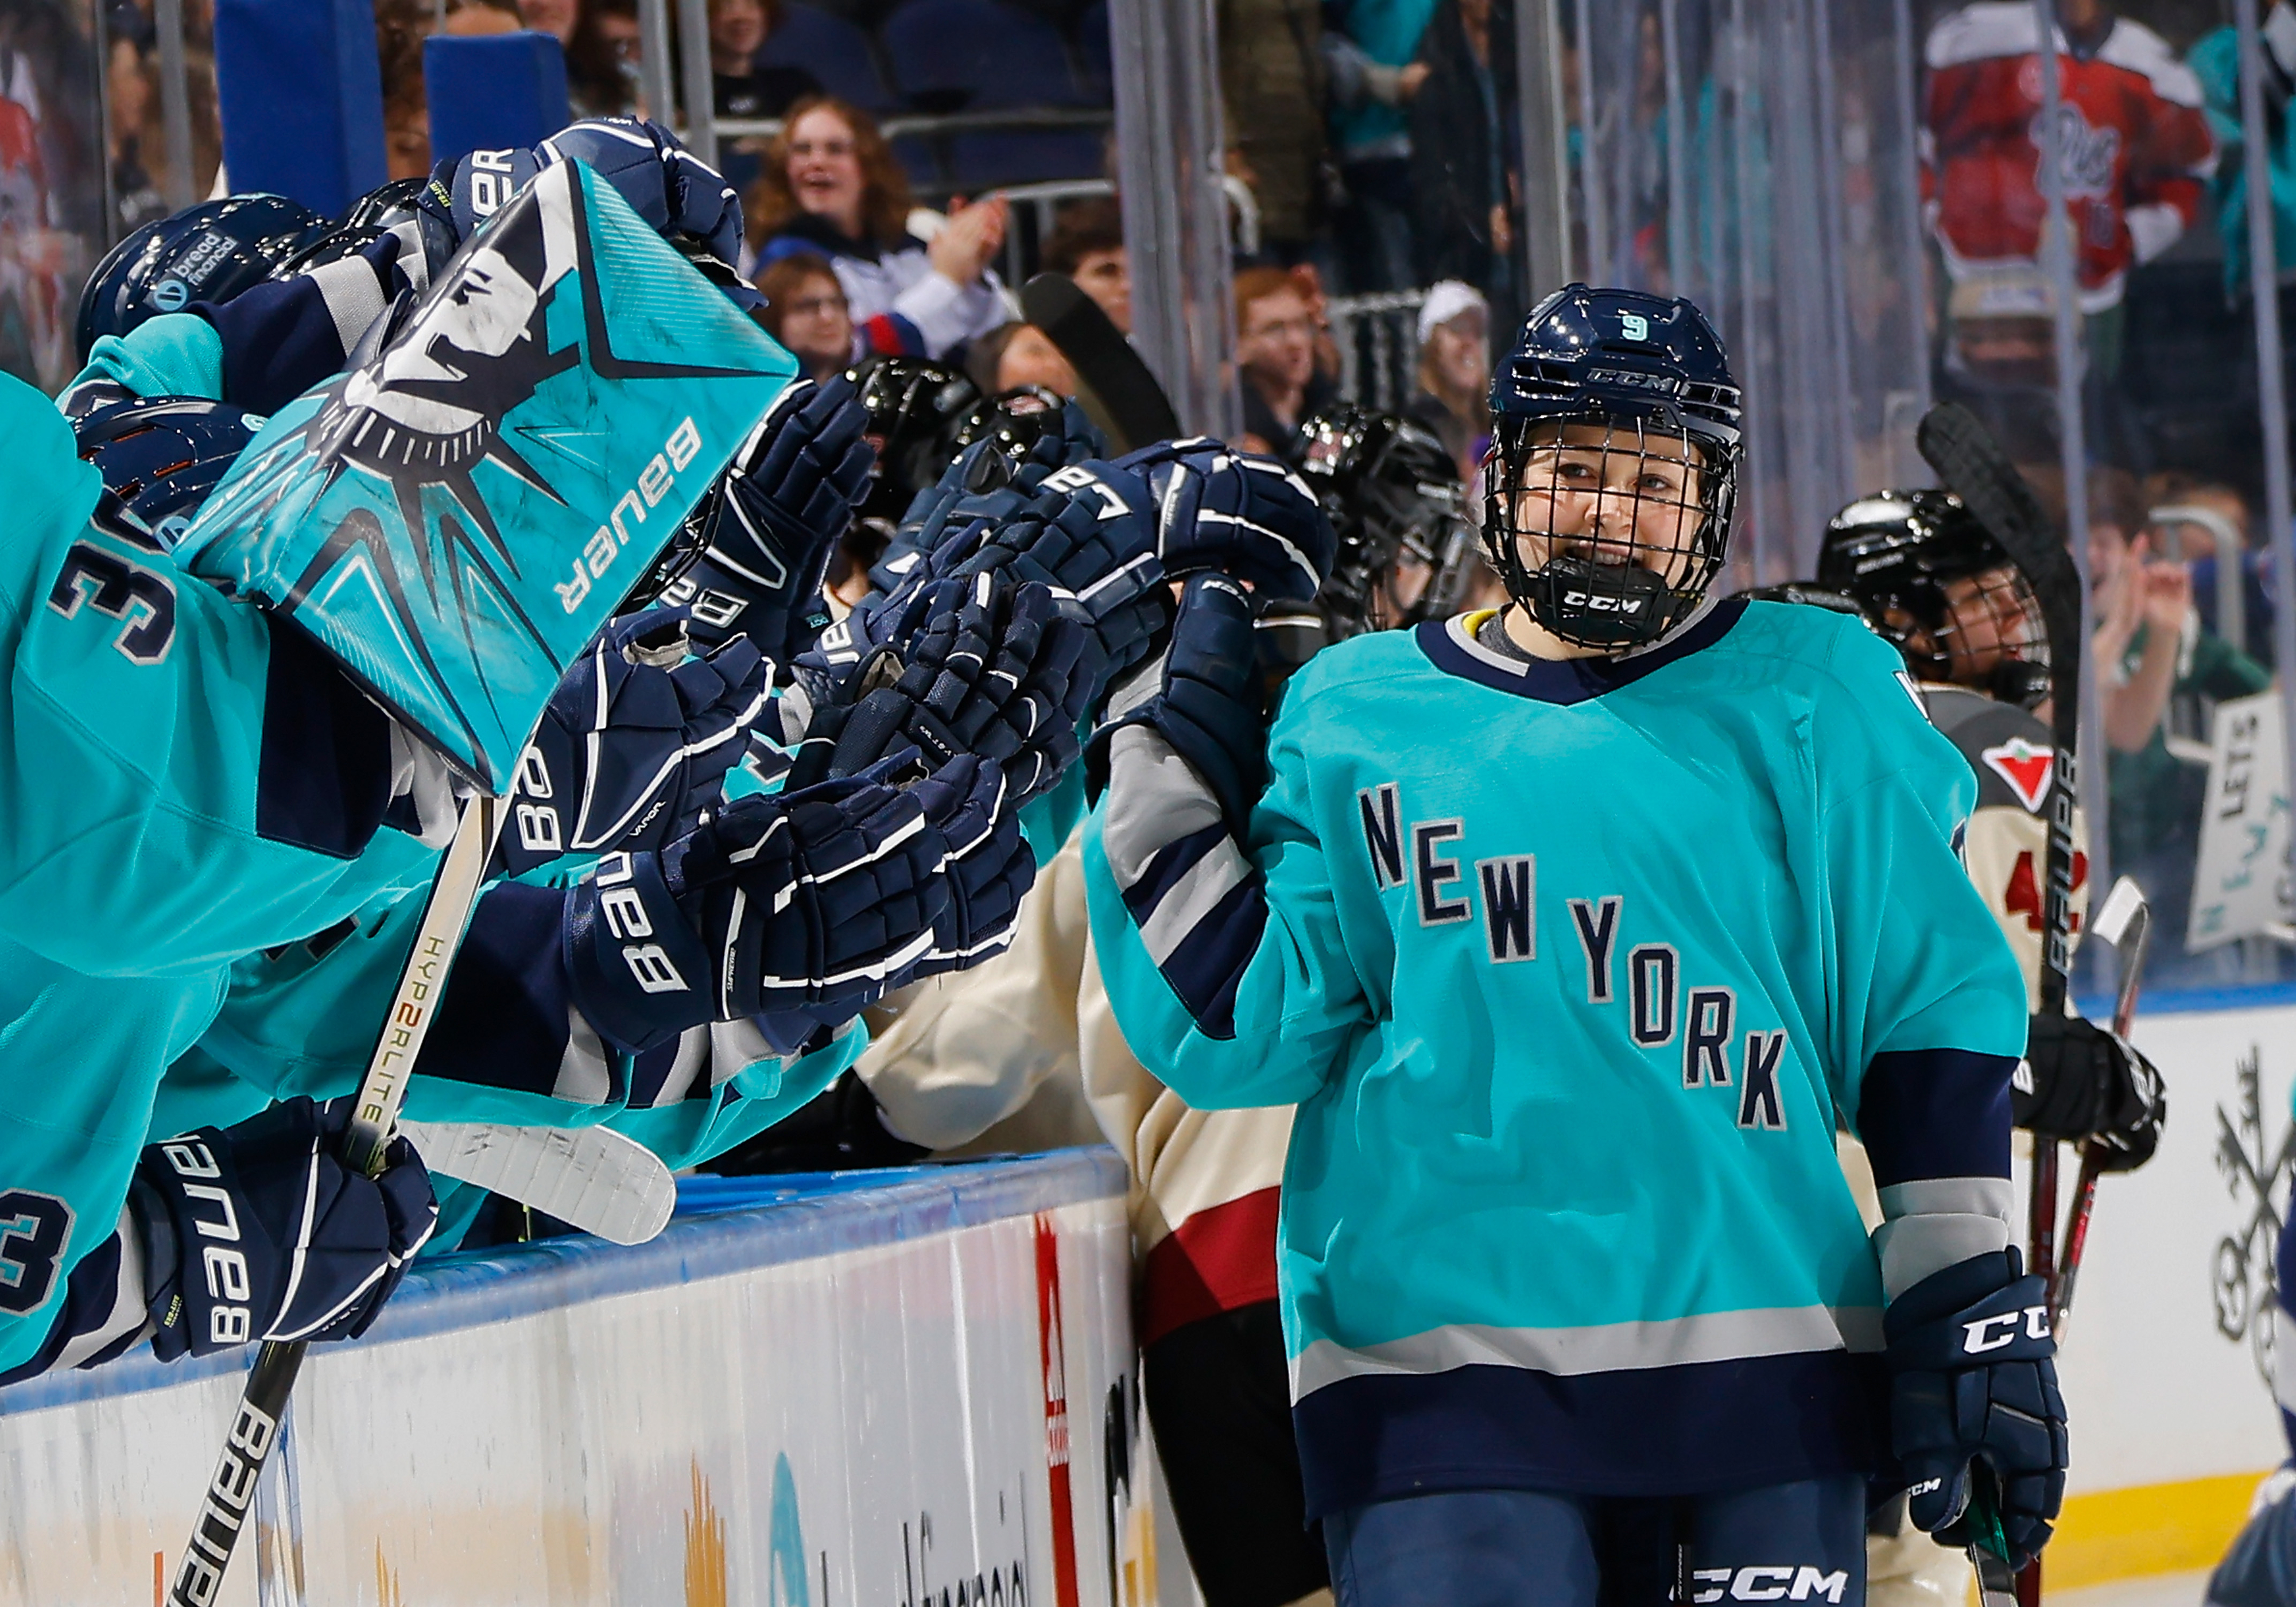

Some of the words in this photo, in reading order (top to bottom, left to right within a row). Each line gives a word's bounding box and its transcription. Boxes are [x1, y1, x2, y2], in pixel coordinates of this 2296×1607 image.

[172, 232, 223, 278] bread
[187, 236, 239, 286] financial
[1622, 315, 1649, 342] 9
[1586, 367, 1676, 392] CCM
[553, 415, 703, 615] BAUER
[1564, 590, 1642, 614] CCM
[629, 800, 666, 837] VAPOR
[596, 850, 691, 994] BAU
[1357, 781, 1538, 965] NEW
[1566, 895, 1788, 1132] YORK
[158, 1133, 250, 1343] BAUE
[1961, 1305, 2051, 1354] CC
[168, 1396, 277, 1607] BAUE
[1668, 1565, 1849, 1605] CCM
